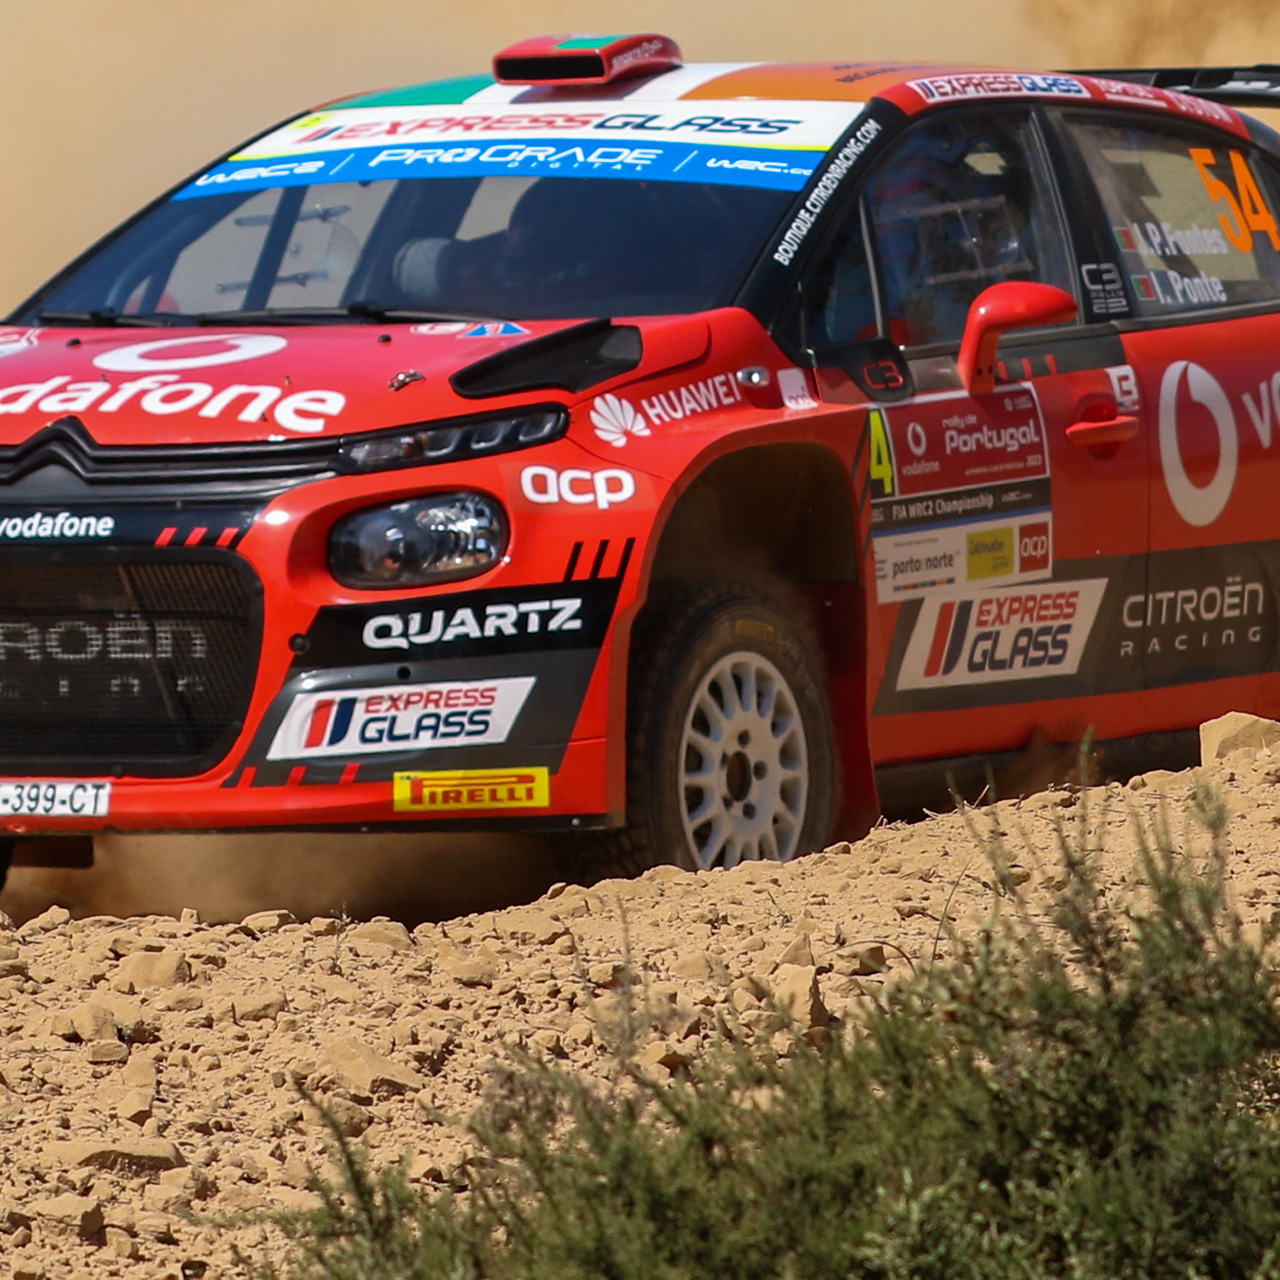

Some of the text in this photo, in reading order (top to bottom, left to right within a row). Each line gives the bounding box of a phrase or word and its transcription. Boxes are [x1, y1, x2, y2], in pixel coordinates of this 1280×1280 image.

[773, 118, 883, 267] BOUTIQUE.CITROENRACING.COM
[1166, 270, 1228, 303] Ponte
[640, 372, 742, 426] HUAWEI
[944, 418, 1041, 456] Portugal
[520, 465, 636, 510] acp
[935, 492, 994, 515] Championship
[925, 552, 954, 570] norte
[362, 598, 583, 650] QUARTZ
[975, 591, 1079, 629] EXPRESS
[967, 623, 1072, 673] GLASS
[1120, 626, 1261, 657] RACING
[363, 686, 498, 714] EXPRESS
[358, 709, 492, 745] GLASS
[410, 774, 536, 805] PIRELLI
